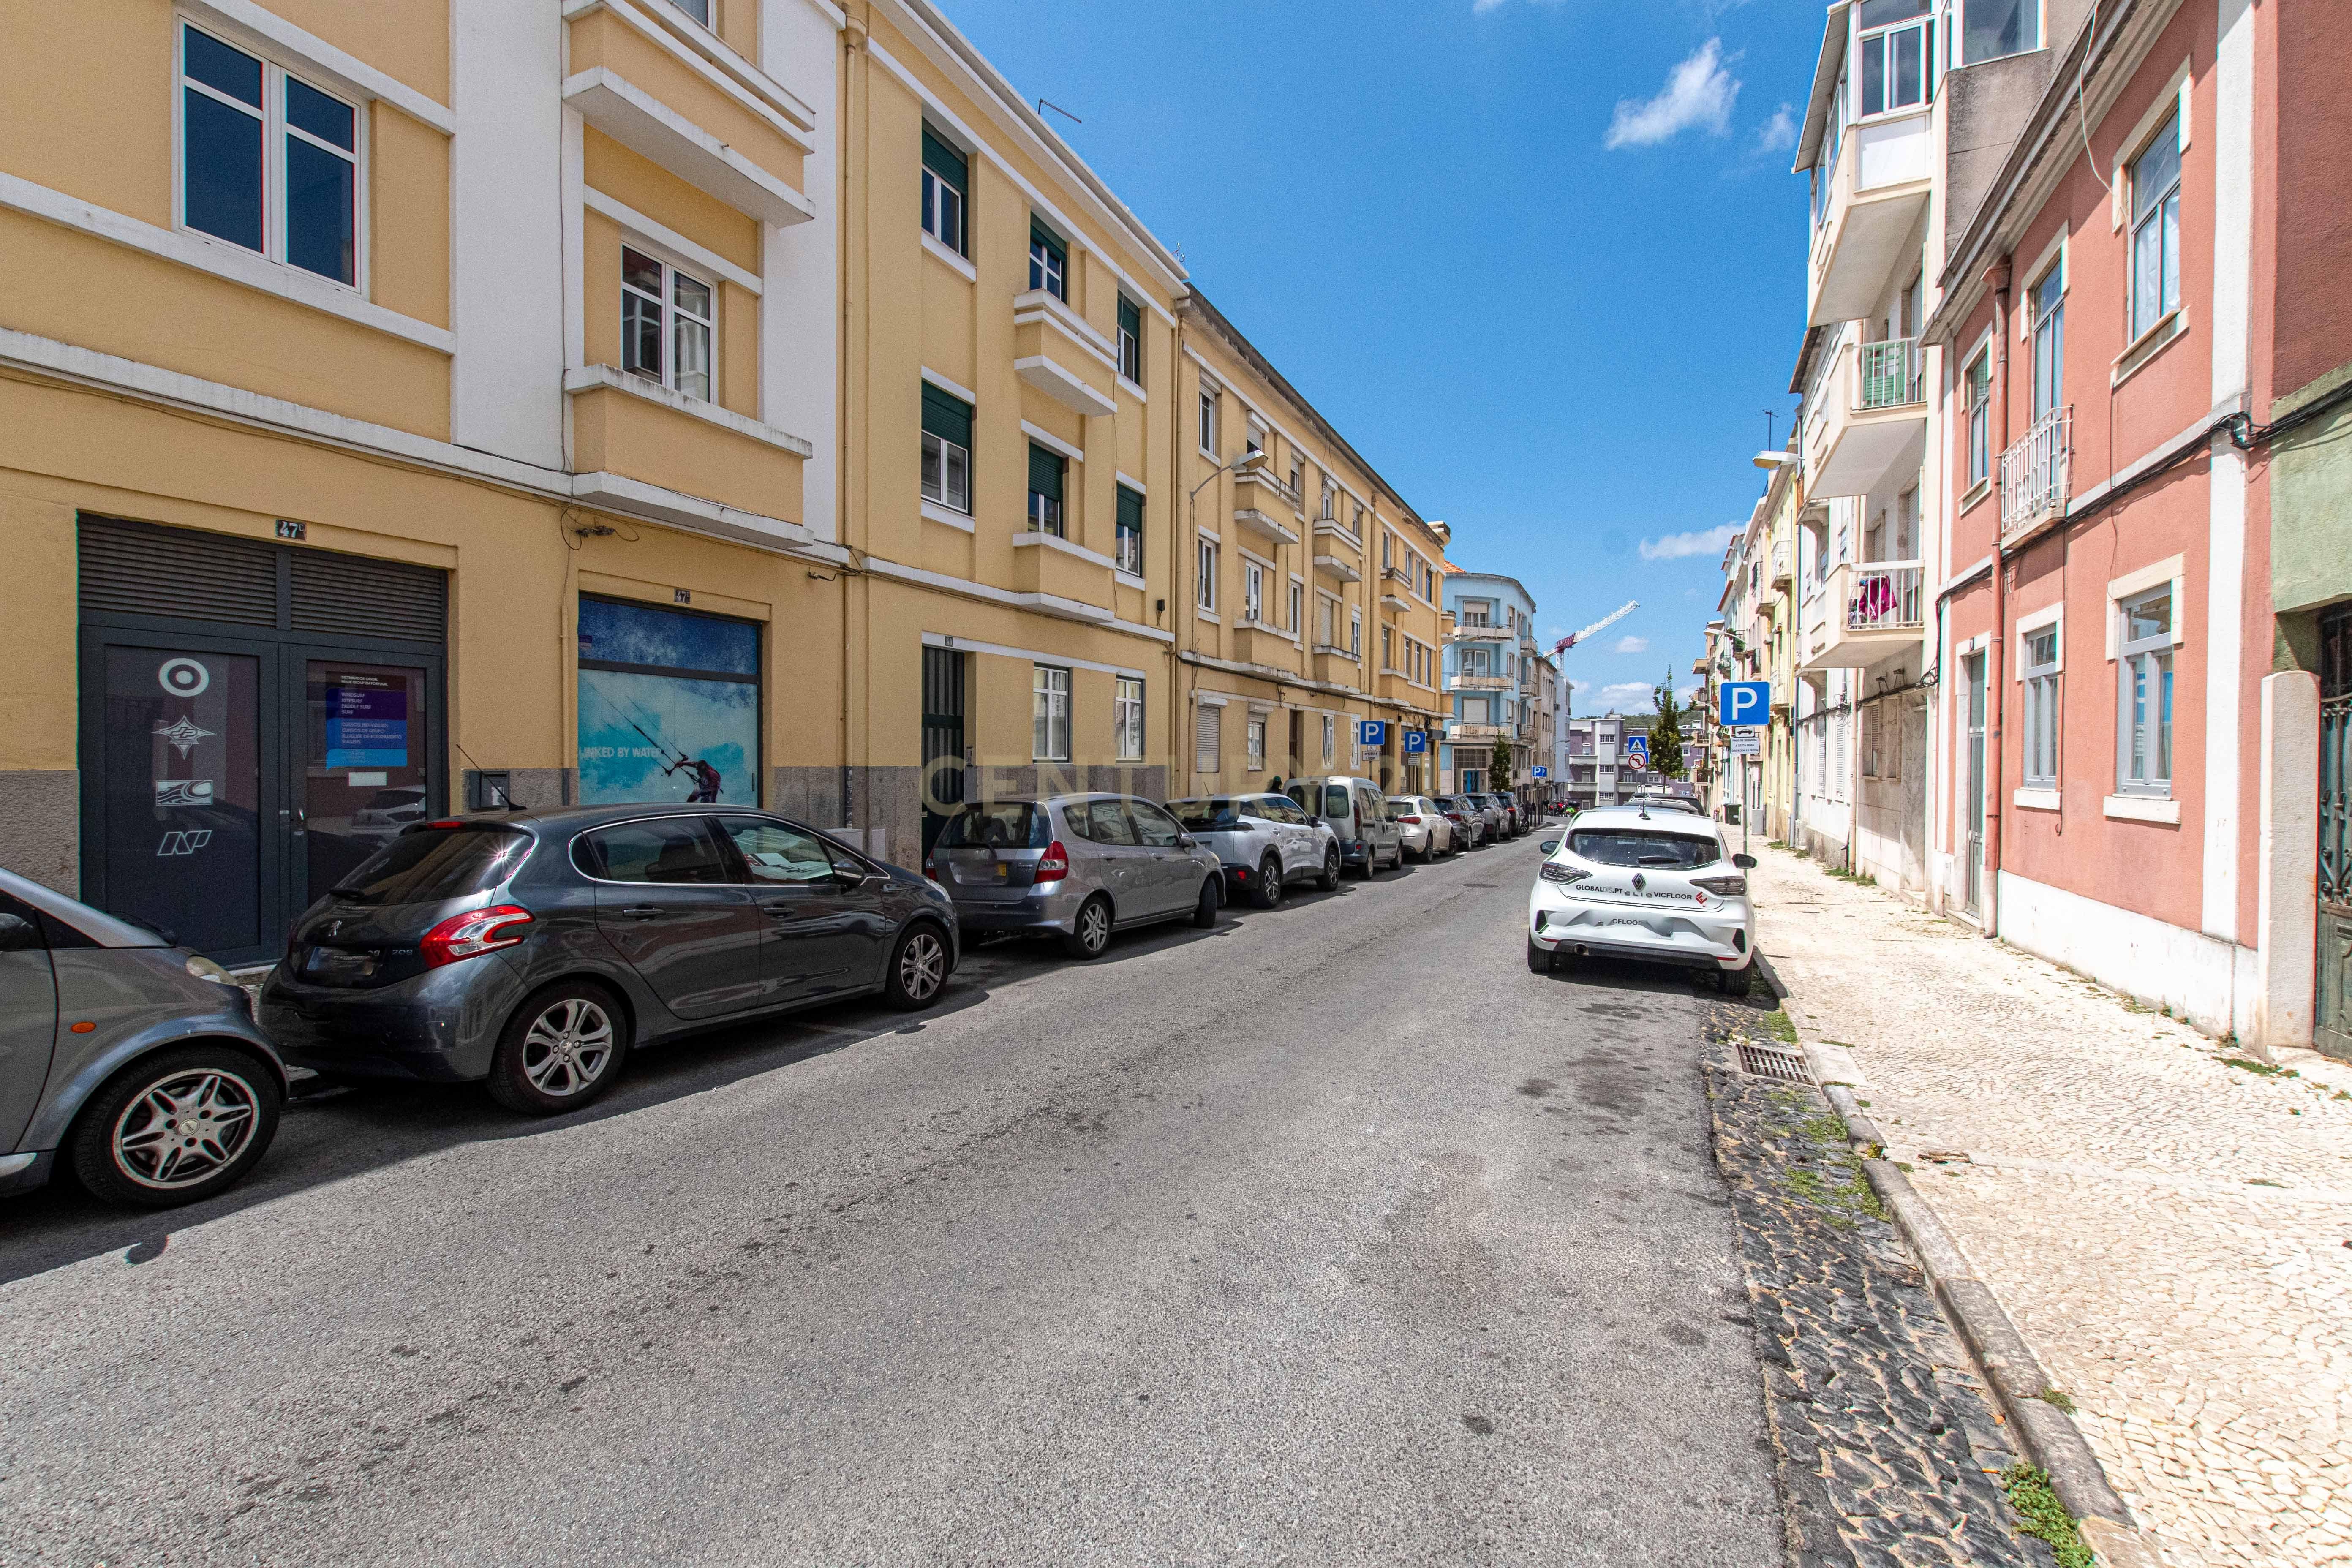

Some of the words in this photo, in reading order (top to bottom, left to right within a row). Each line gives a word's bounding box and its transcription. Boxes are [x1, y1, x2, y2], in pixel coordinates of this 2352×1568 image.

[1732, 687, 1757, 720] P
[1365, 723, 1379, 742] P
[1409, 734, 1421, 750] P
[618, 747, 629, 757] BY
[632, 747, 662, 757] WATER
[1534, 767, 1541, 776] P
[1654, 892, 1692, 900] VICFLOOR
